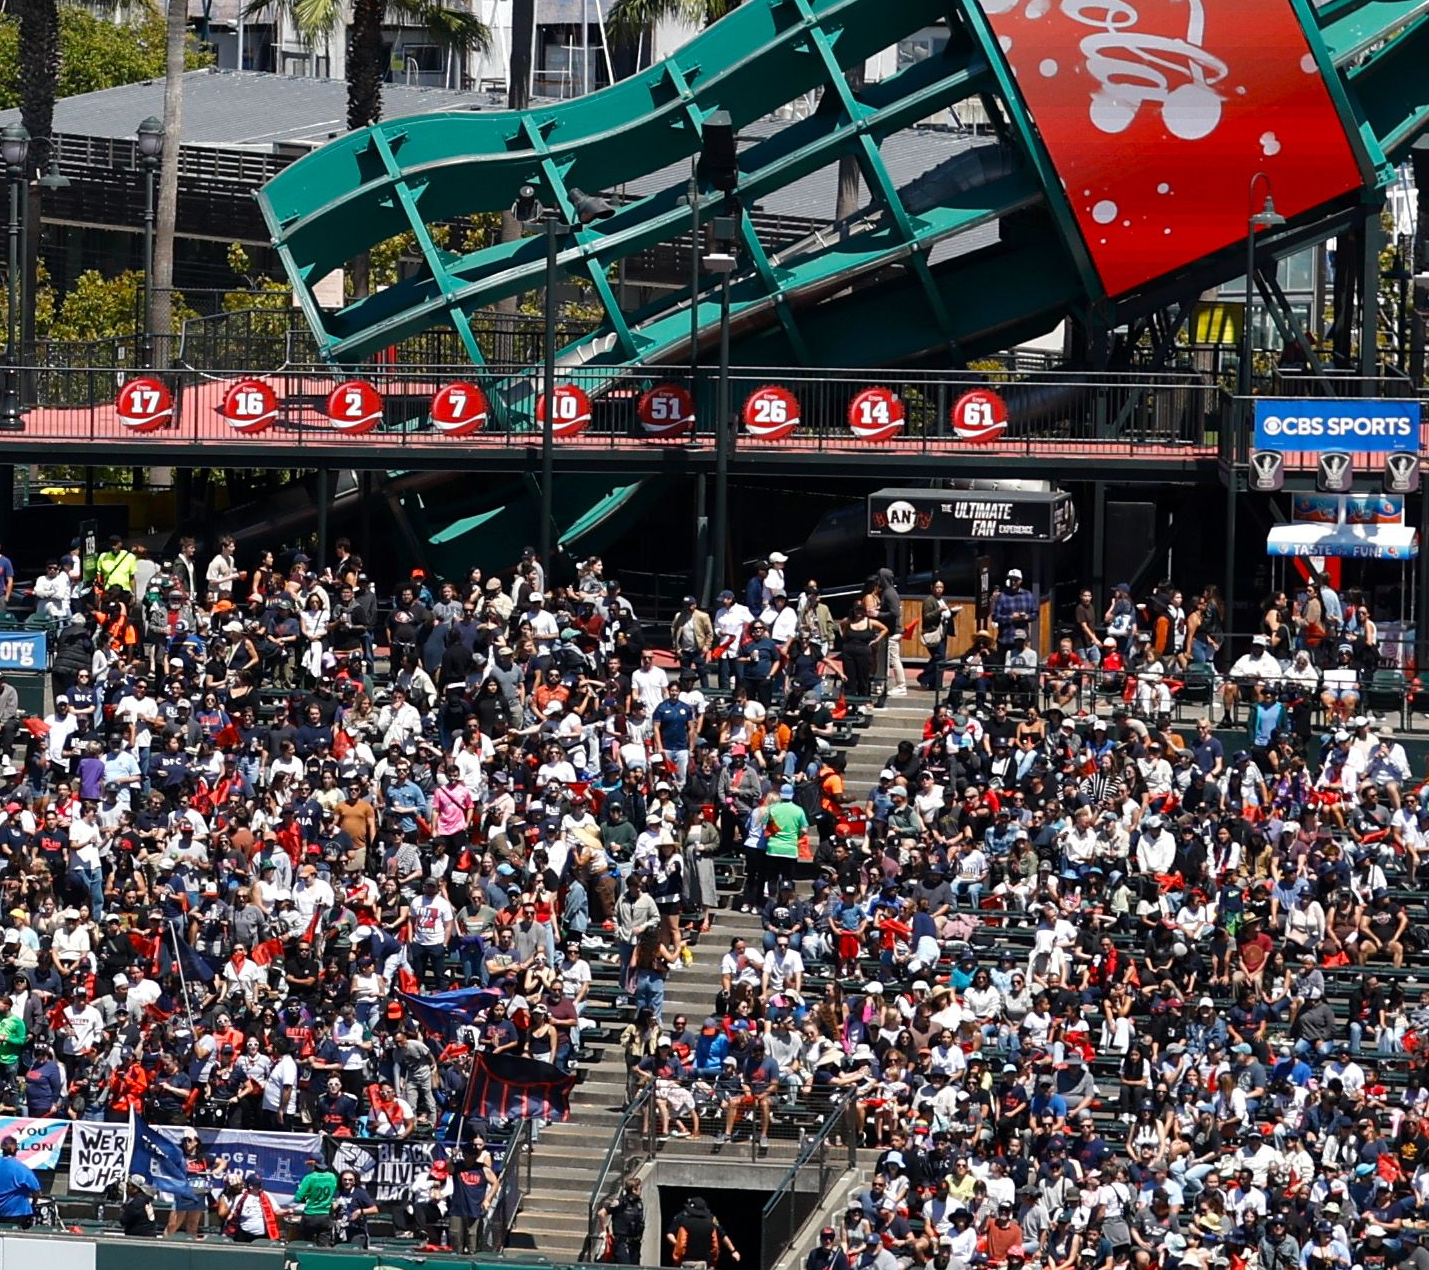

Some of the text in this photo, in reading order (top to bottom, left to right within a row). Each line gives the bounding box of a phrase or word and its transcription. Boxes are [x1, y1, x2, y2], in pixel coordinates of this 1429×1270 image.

[130, 390, 160, 414] 17
[235, 392, 265, 416] 16
[345, 394, 363, 417] 2
[448, 396, 467, 418] 7
[650, 397, 682, 423] 51
[753, 399, 788, 424] 26
[857, 399, 891, 424] 14
[964, 401, 996, 426] 61
[1281, 417, 1411, 436] CBS SPORTS
[954, 502, 1013, 520] ULTIMATE
[971, 519, 1034, 537] FAN EXPERIENCE
[1293, 544, 1383, 558] TASTE FUN!
[17, 1127, 48, 1137] YOU
[79, 1130, 128, 1152] WE'R
[78, 1150, 125, 1168] NOT A
[377, 1142, 436, 1162] BLACK
[316, 1186, 331, 1199] 29
